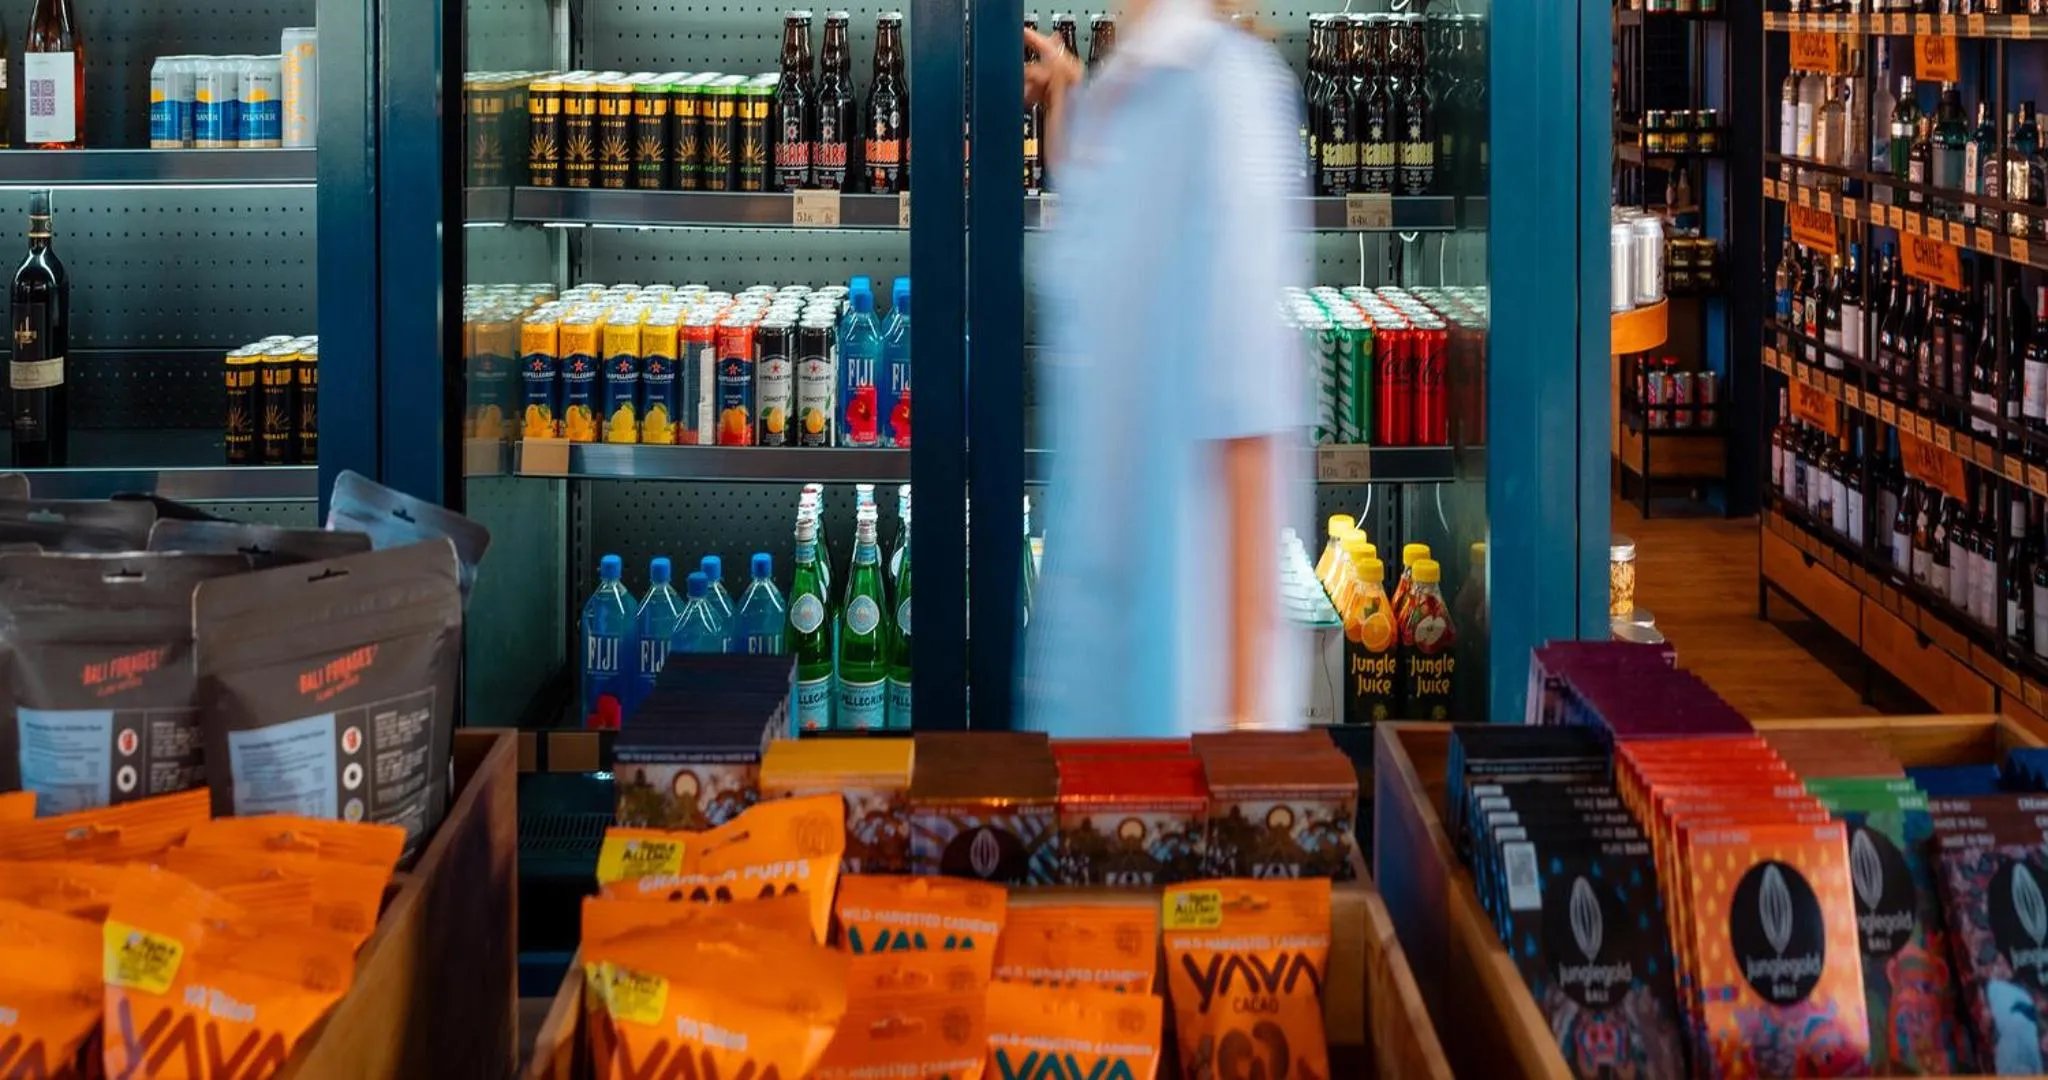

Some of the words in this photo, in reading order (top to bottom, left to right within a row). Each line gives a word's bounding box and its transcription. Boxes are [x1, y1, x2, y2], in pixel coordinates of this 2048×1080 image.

[1924, 36, 1946, 66] GIN
[1913, 237, 1945, 271] CHILE
[847, 358, 875, 387] FIJI
[587, 635, 619, 672] FIJI
[1352, 653, 1396, 678] Jungle
[1410, 653, 1455, 678] Jungle
[299, 667, 325, 694] BALI
[1357, 674, 1392, 697] Juice
[1417, 675, 1450, 698] Juice
[744, 859, 810, 880] PUFFS
[1558, 961, 1633, 988] junglegold
[1746, 953, 1822, 982] junglegold
[1181, 951, 1325, 1015] YAVA
[1233, 996, 1280, 1014] CACAO
